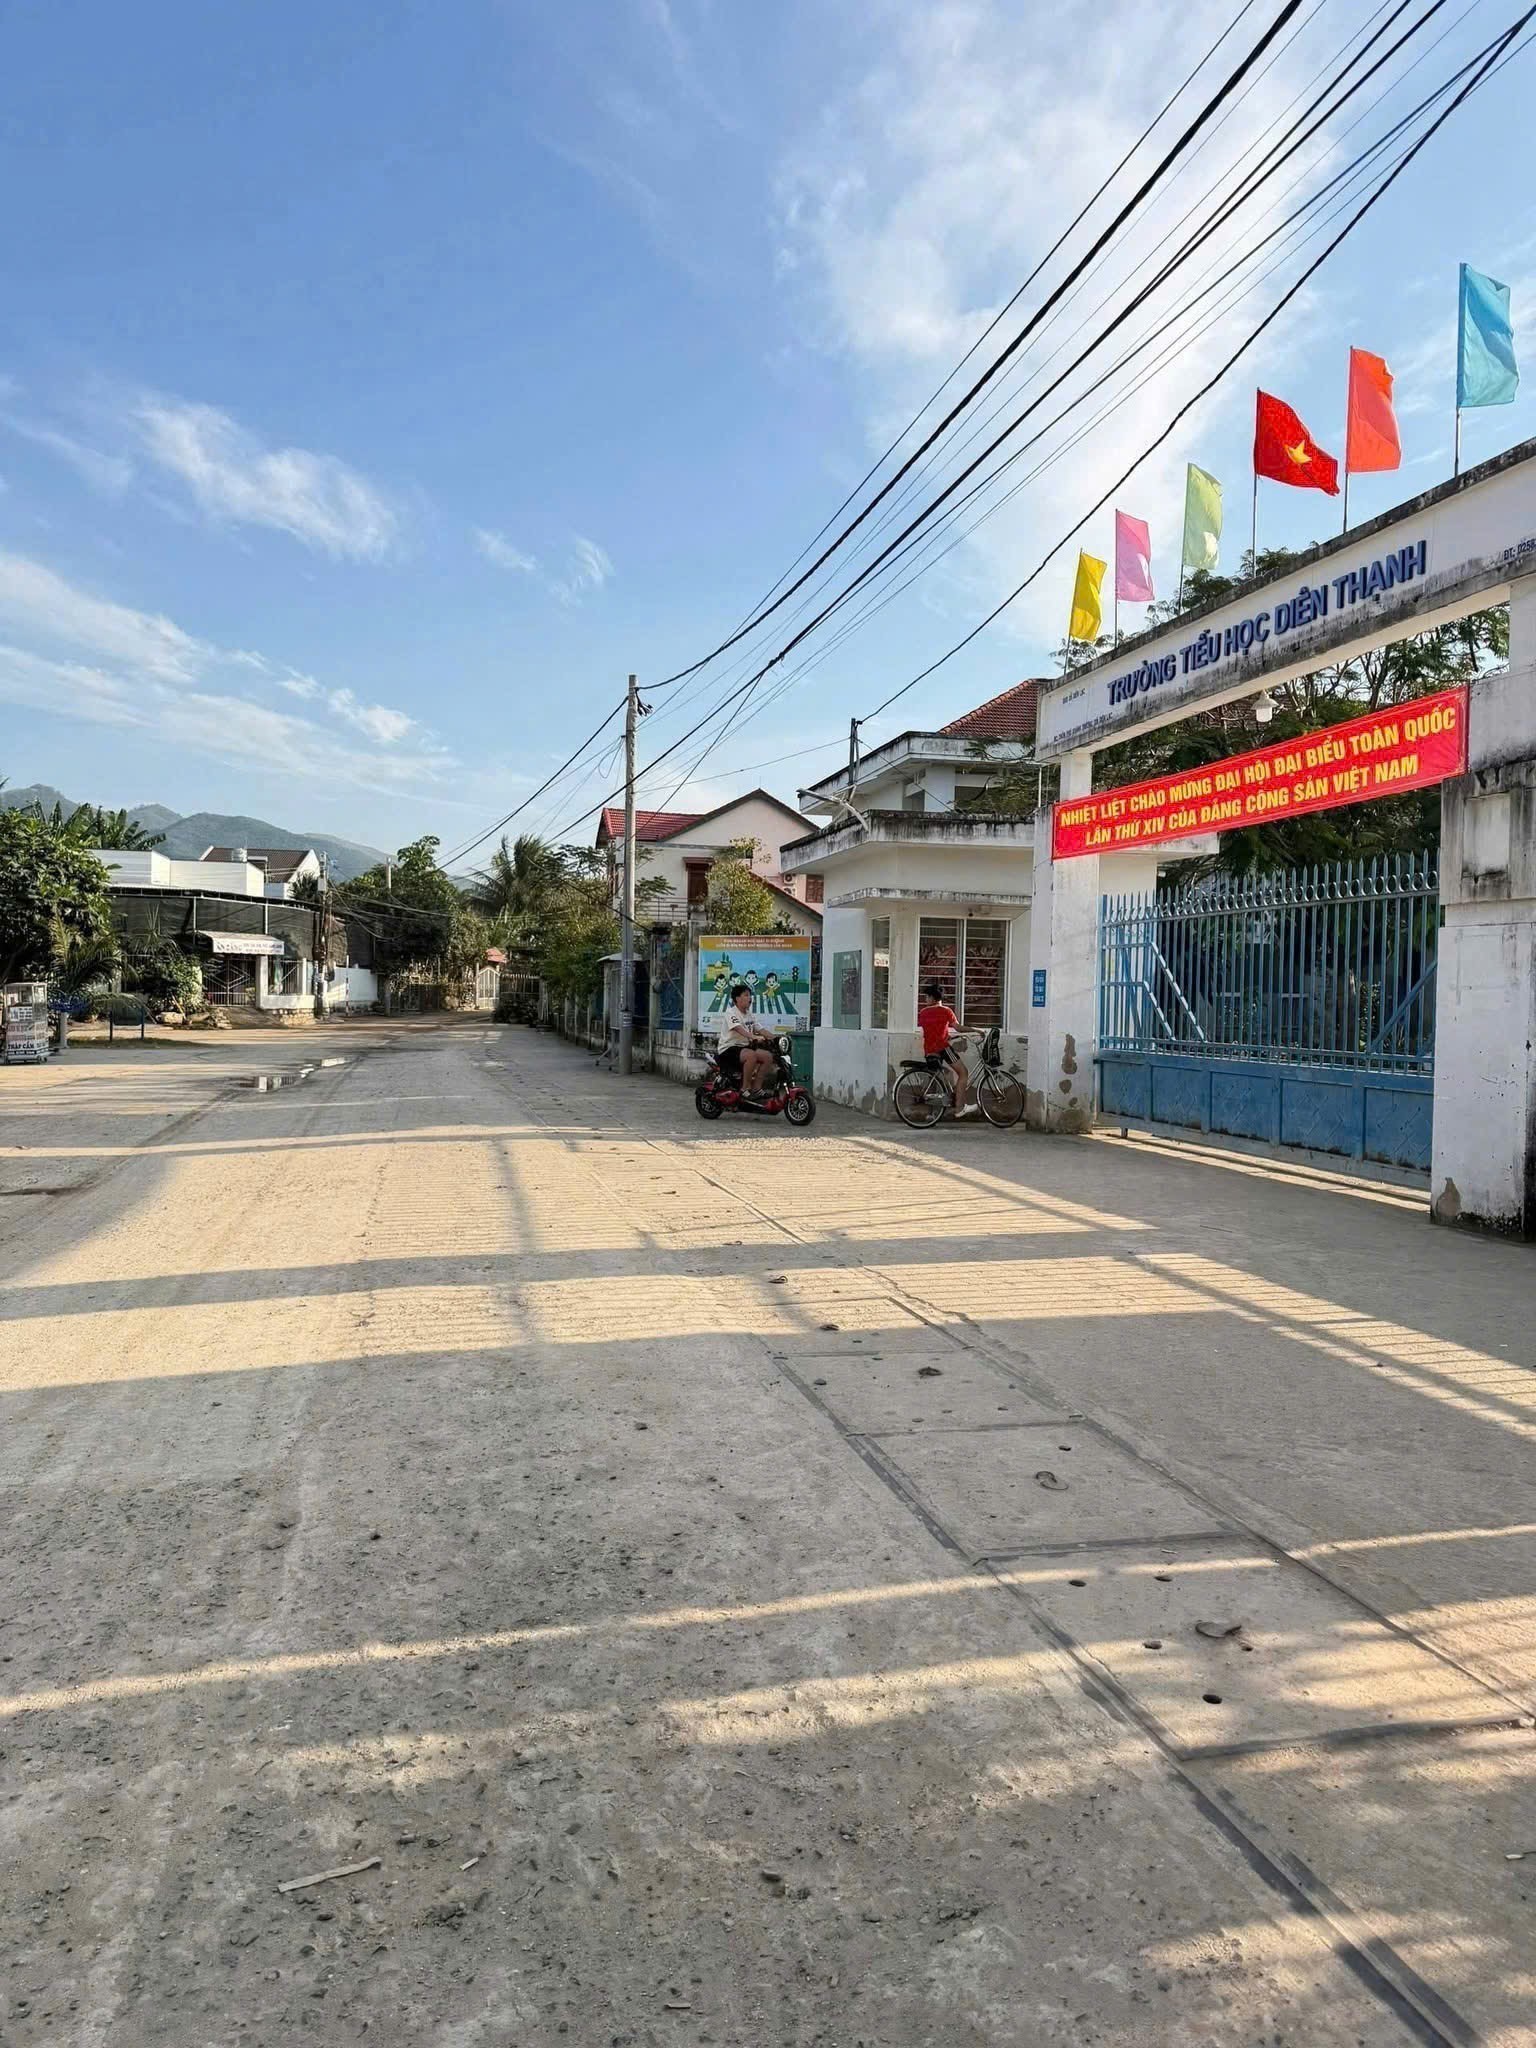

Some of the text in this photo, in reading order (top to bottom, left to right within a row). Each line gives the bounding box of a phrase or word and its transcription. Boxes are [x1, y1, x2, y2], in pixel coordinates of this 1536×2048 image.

[1107, 539, 1427, 706] TRƯỜNG TIỂU HỌC DIÊN THẠNH
[1061, 703, 1456, 827] NHIỆT LIỆT CHÀO MỪNG ĐẠI HỘI ĐẠI BIỂU TOÀN QUỐC
[1085, 754, 1419, 846] LẦN THỨ XIV CỦA ĐẢNG CỘNG SẢN VIỆT NAM
